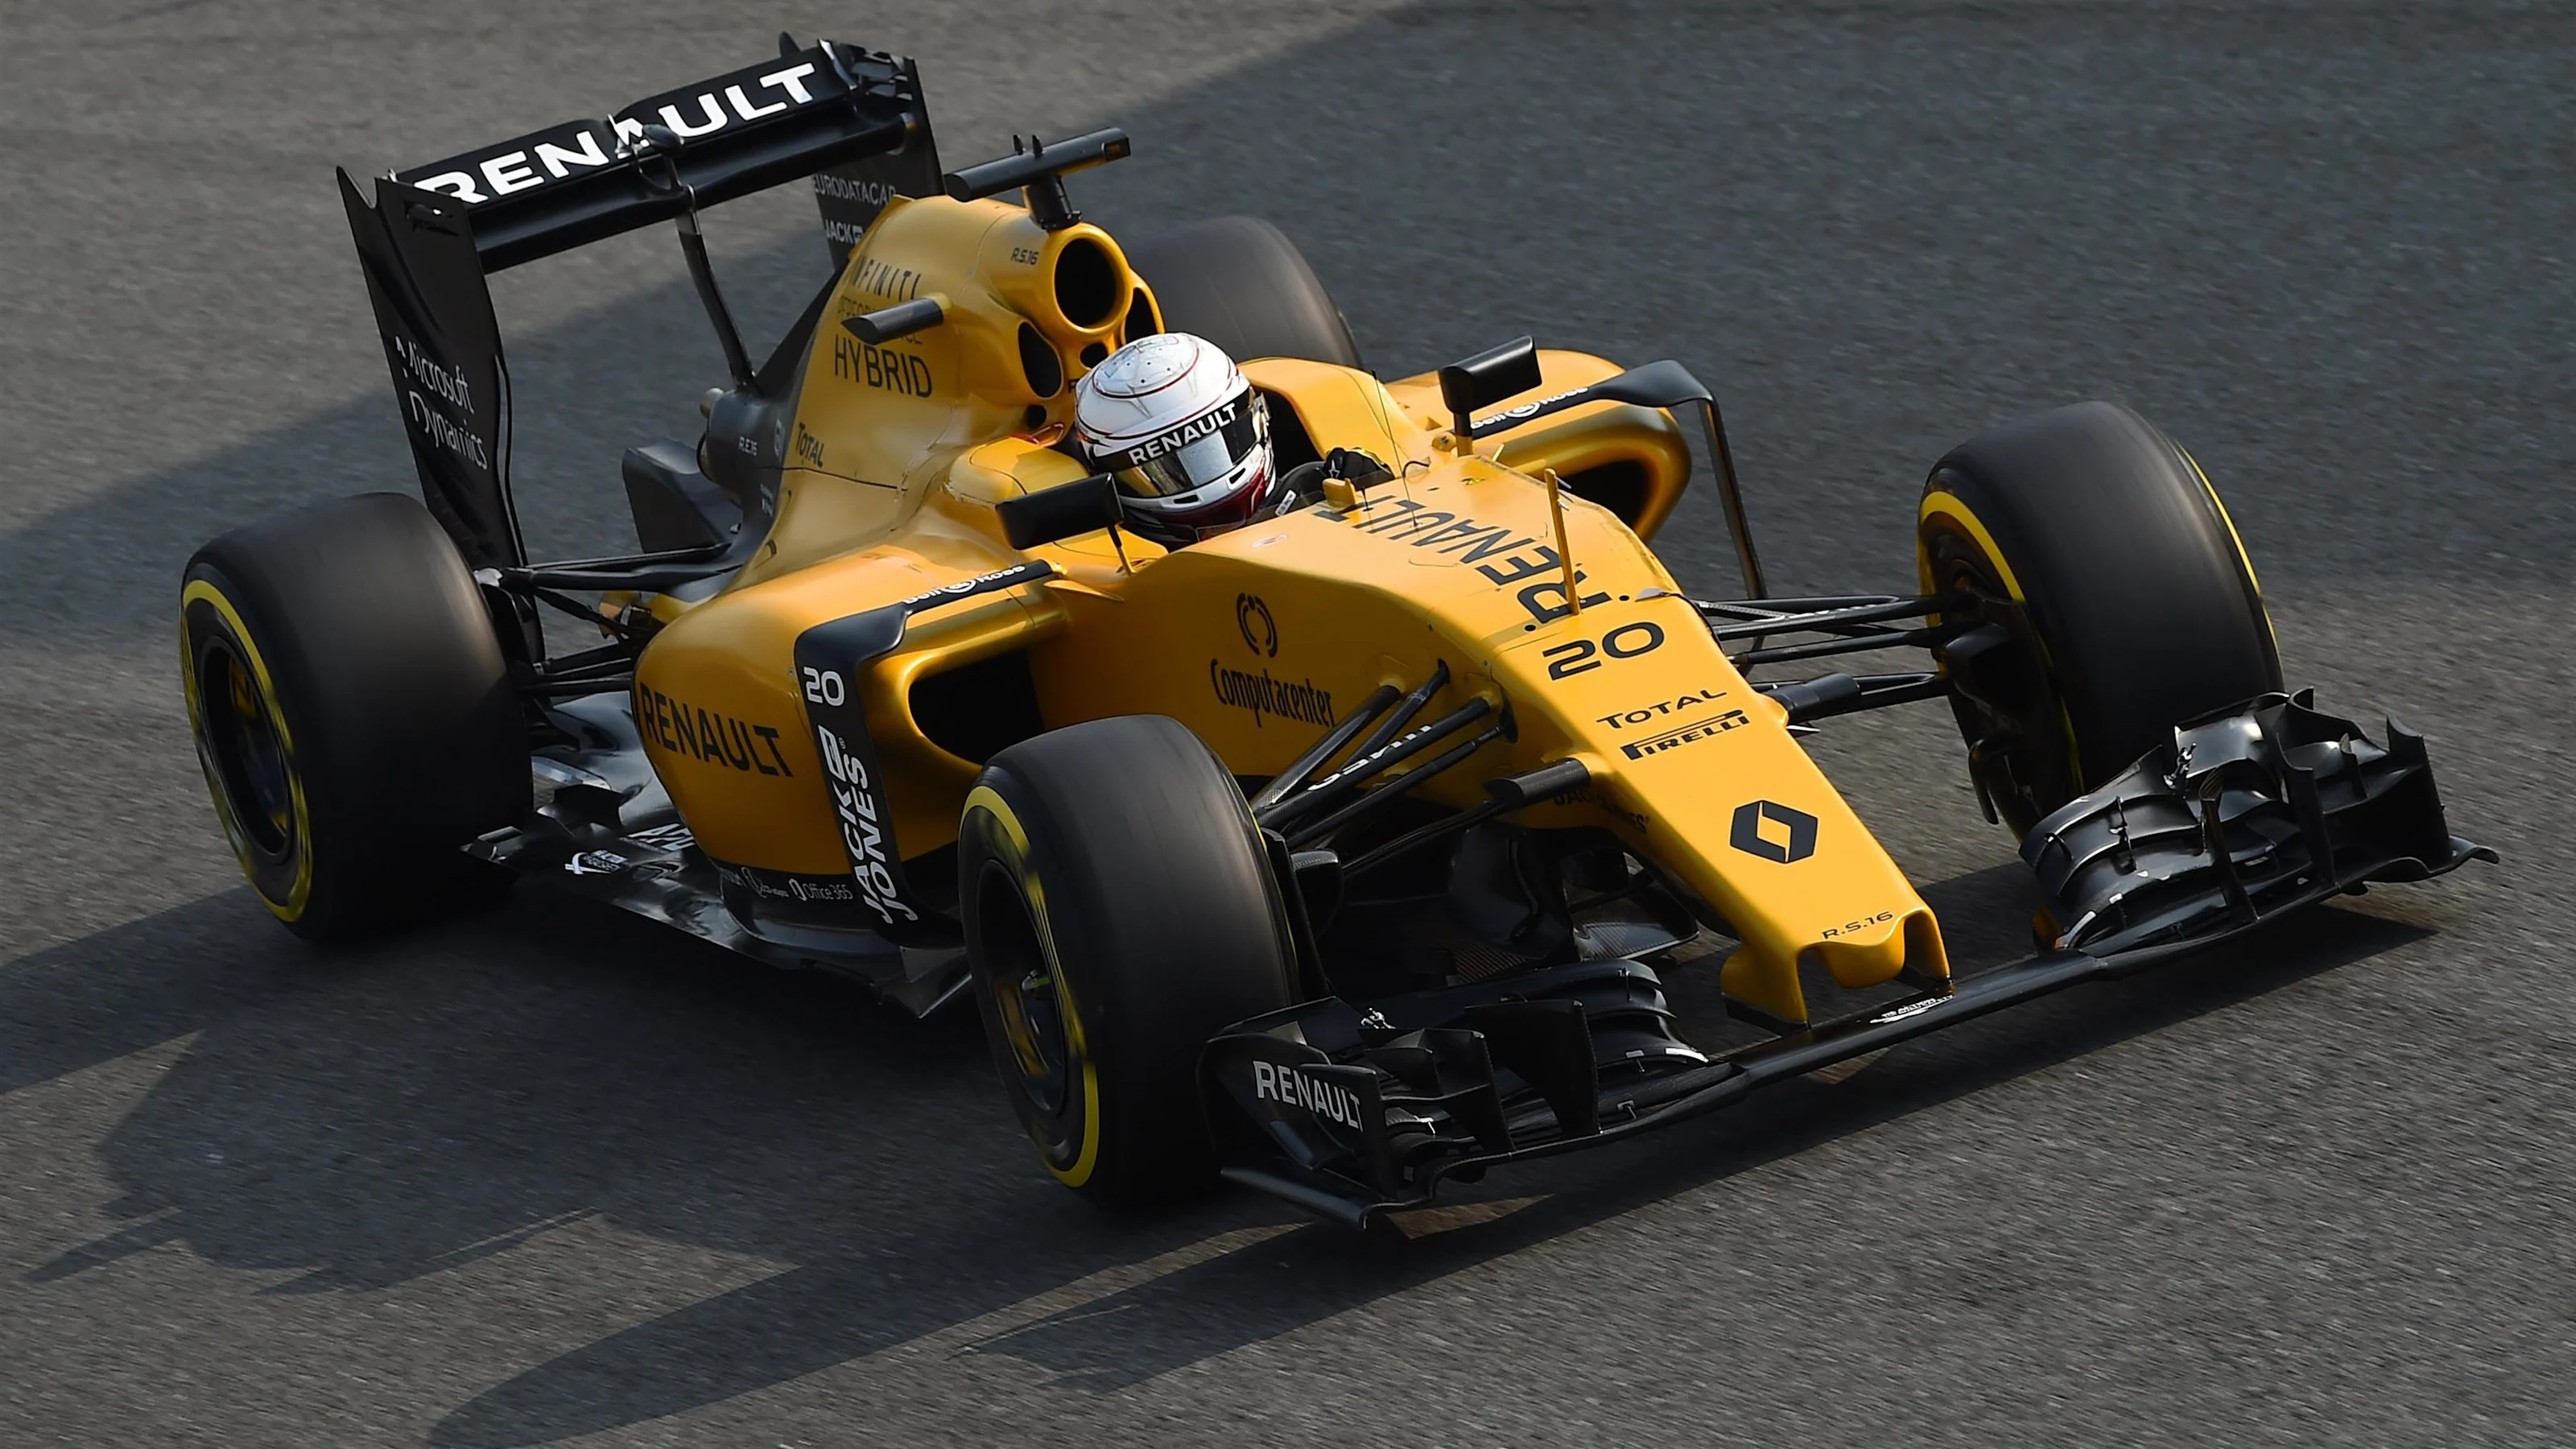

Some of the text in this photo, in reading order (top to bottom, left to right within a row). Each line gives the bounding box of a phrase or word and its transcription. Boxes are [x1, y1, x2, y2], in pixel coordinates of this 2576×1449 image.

[408, 341, 475, 415] Microsoft
[835, 334, 932, 398] HYBRID
[409, 390, 488, 469] Dynamics
[1128, 402, 1236, 465] RENAULT
[1312, 494, 1612, 625] RENAULT
[1542, 621, 1666, 680] 20
[804, 667, 845, 707] 20
[1211, 658, 1335, 728] Computacenter
[640, 682, 794, 778] RENAULT
[1620, 709, 1750, 761] PIRELLI
[844, 753, 919, 921] JONES
[1822, 910, 1894, 940] R.S.16
[1253, 1060, 1364, 1133] RENAULT
